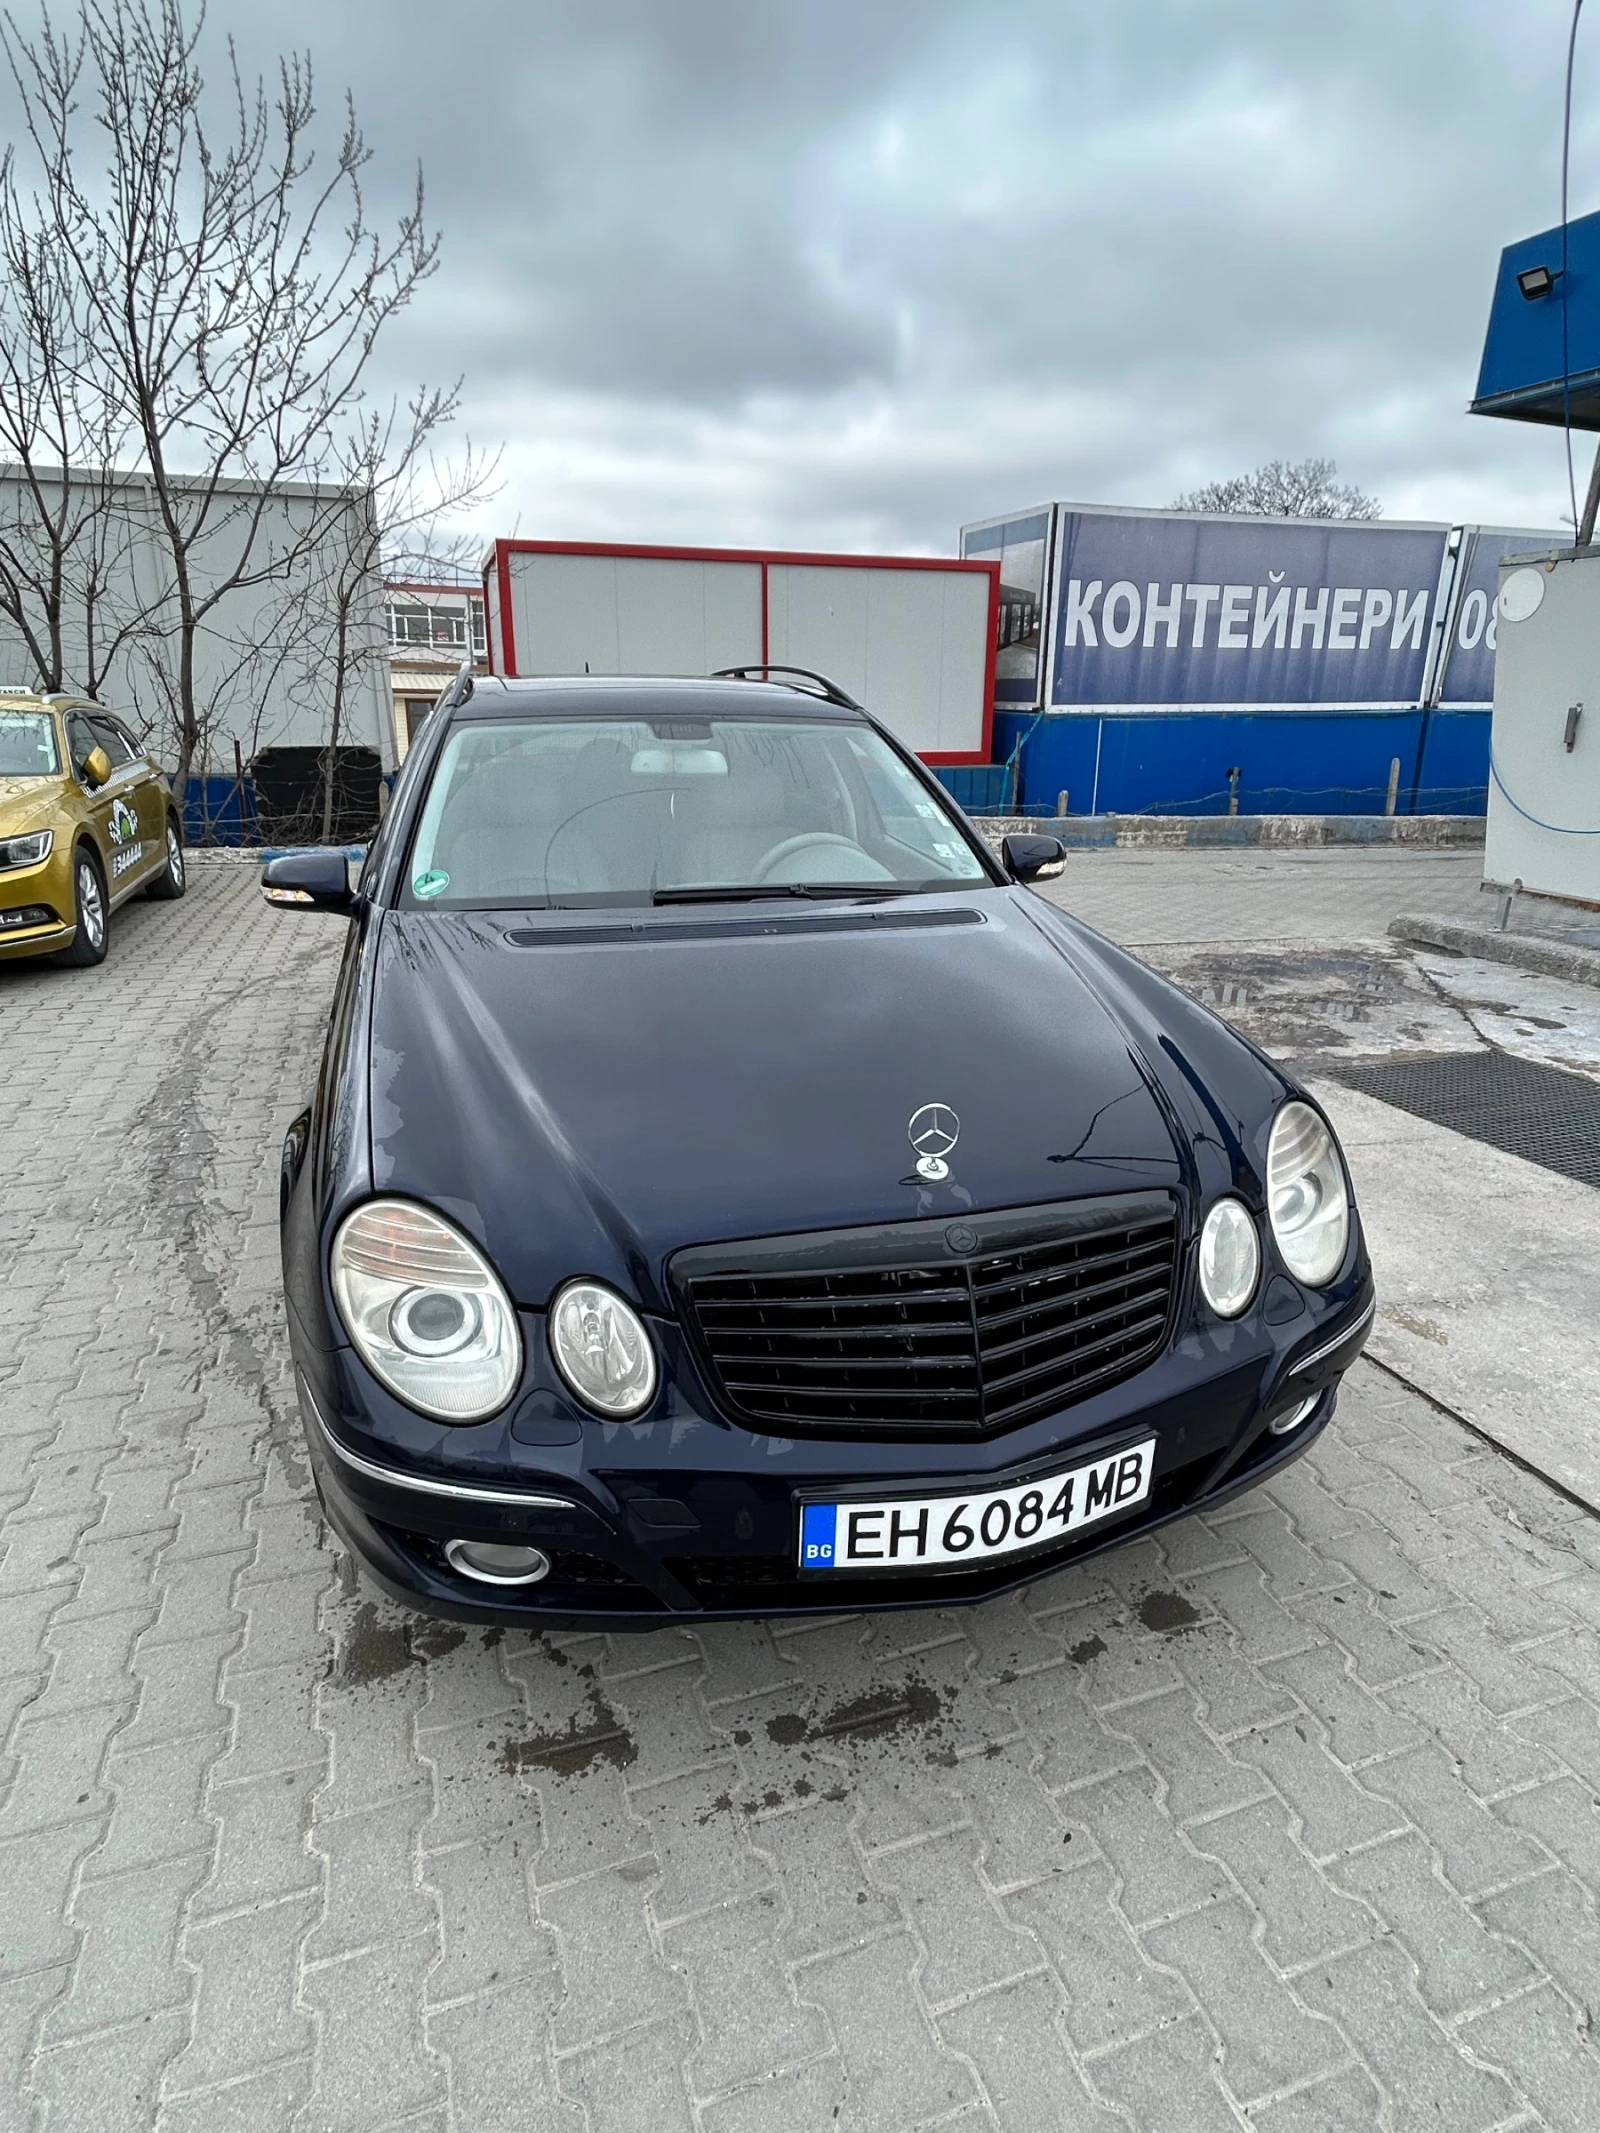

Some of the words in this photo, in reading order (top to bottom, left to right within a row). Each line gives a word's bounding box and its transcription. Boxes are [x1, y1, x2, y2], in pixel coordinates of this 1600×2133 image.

[1063, 569, 1430, 650] КОНТЕЙНЕРИ
[847, 1508, 929, 1559] EH
[942, 1478, 1075, 1553] 6084
[1083, 1452, 1143, 1517] MB
[806, 1544, 832, 1559] BG
